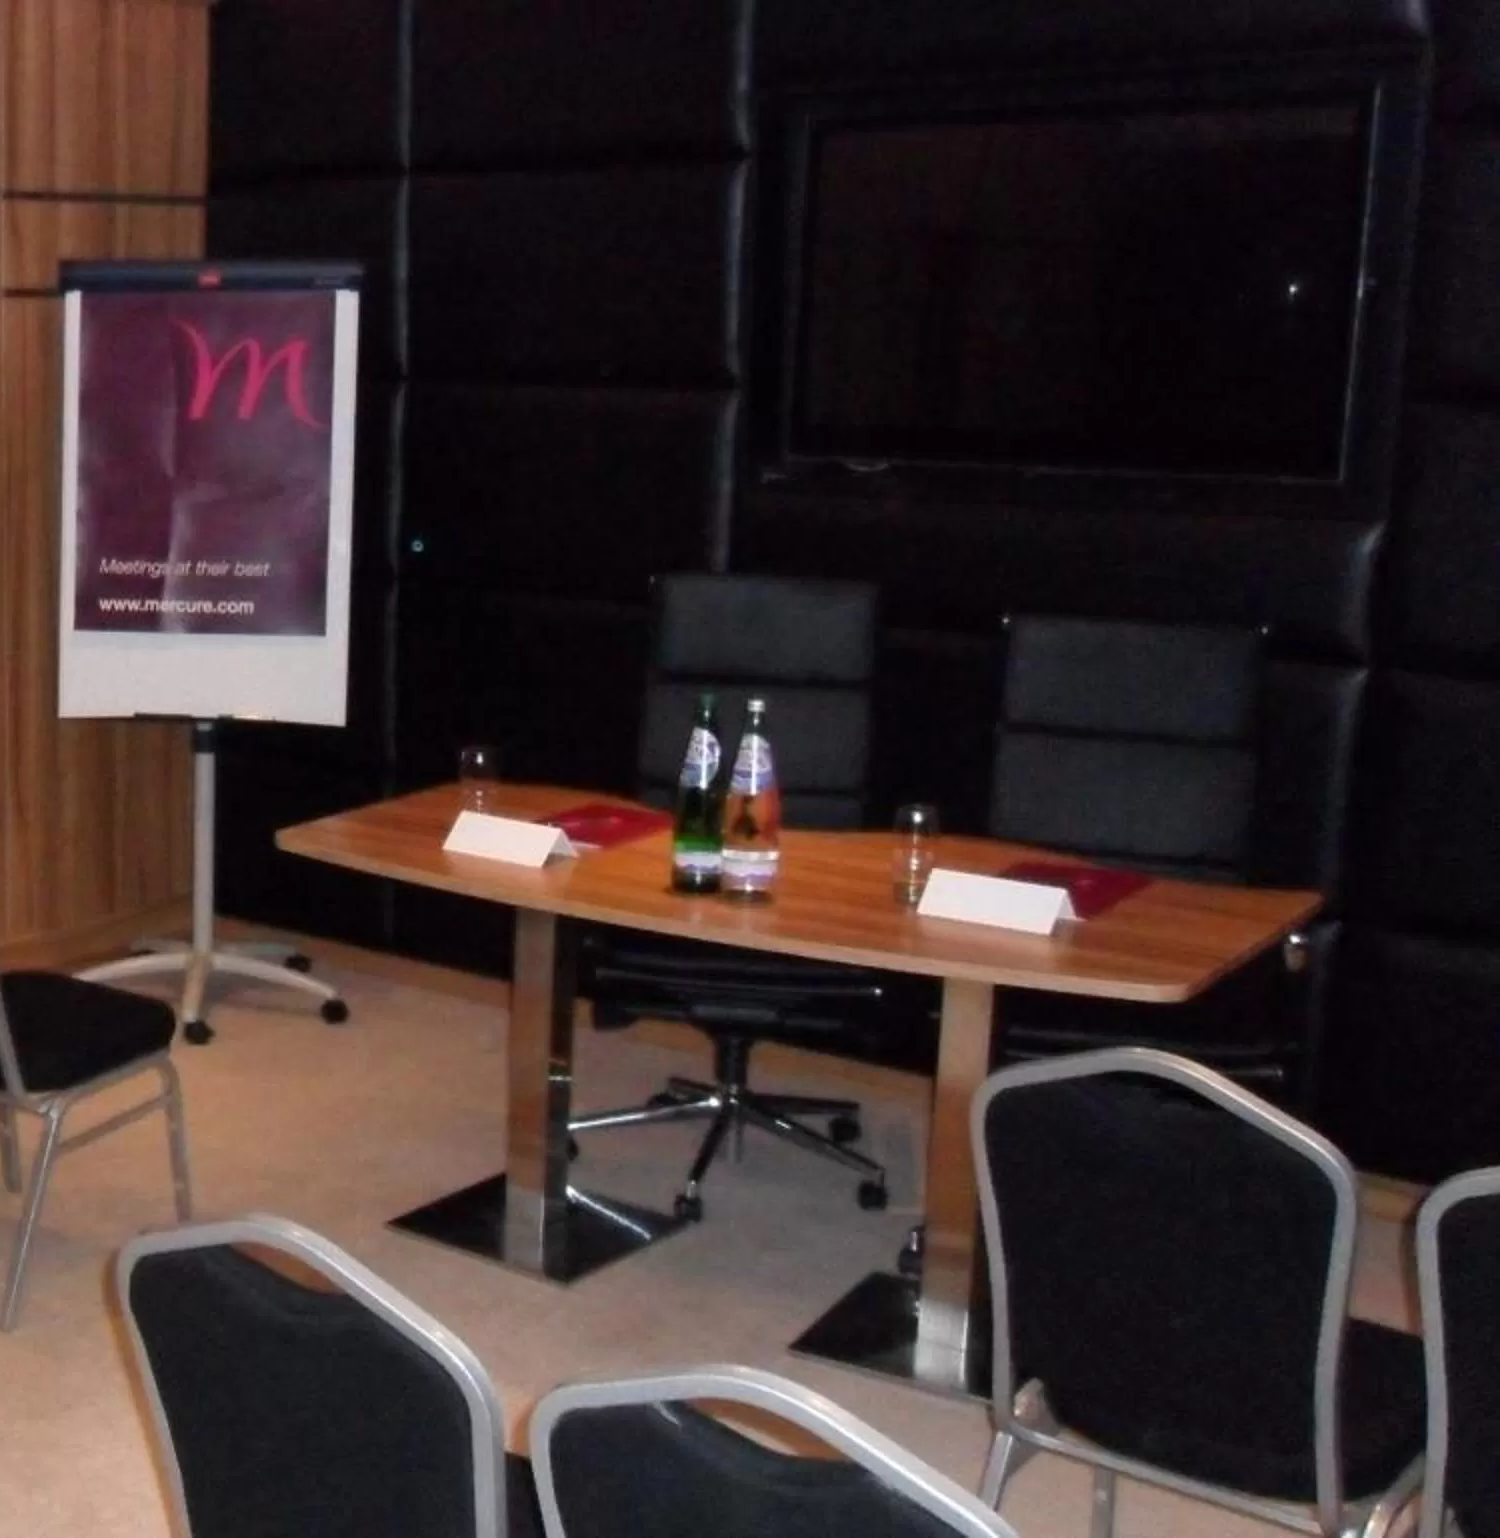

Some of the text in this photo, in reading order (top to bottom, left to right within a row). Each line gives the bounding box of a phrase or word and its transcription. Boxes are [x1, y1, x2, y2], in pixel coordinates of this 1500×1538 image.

[99, 557, 271, 579] Meetings at their best
[98, 597, 255, 615] www.mercure.com
